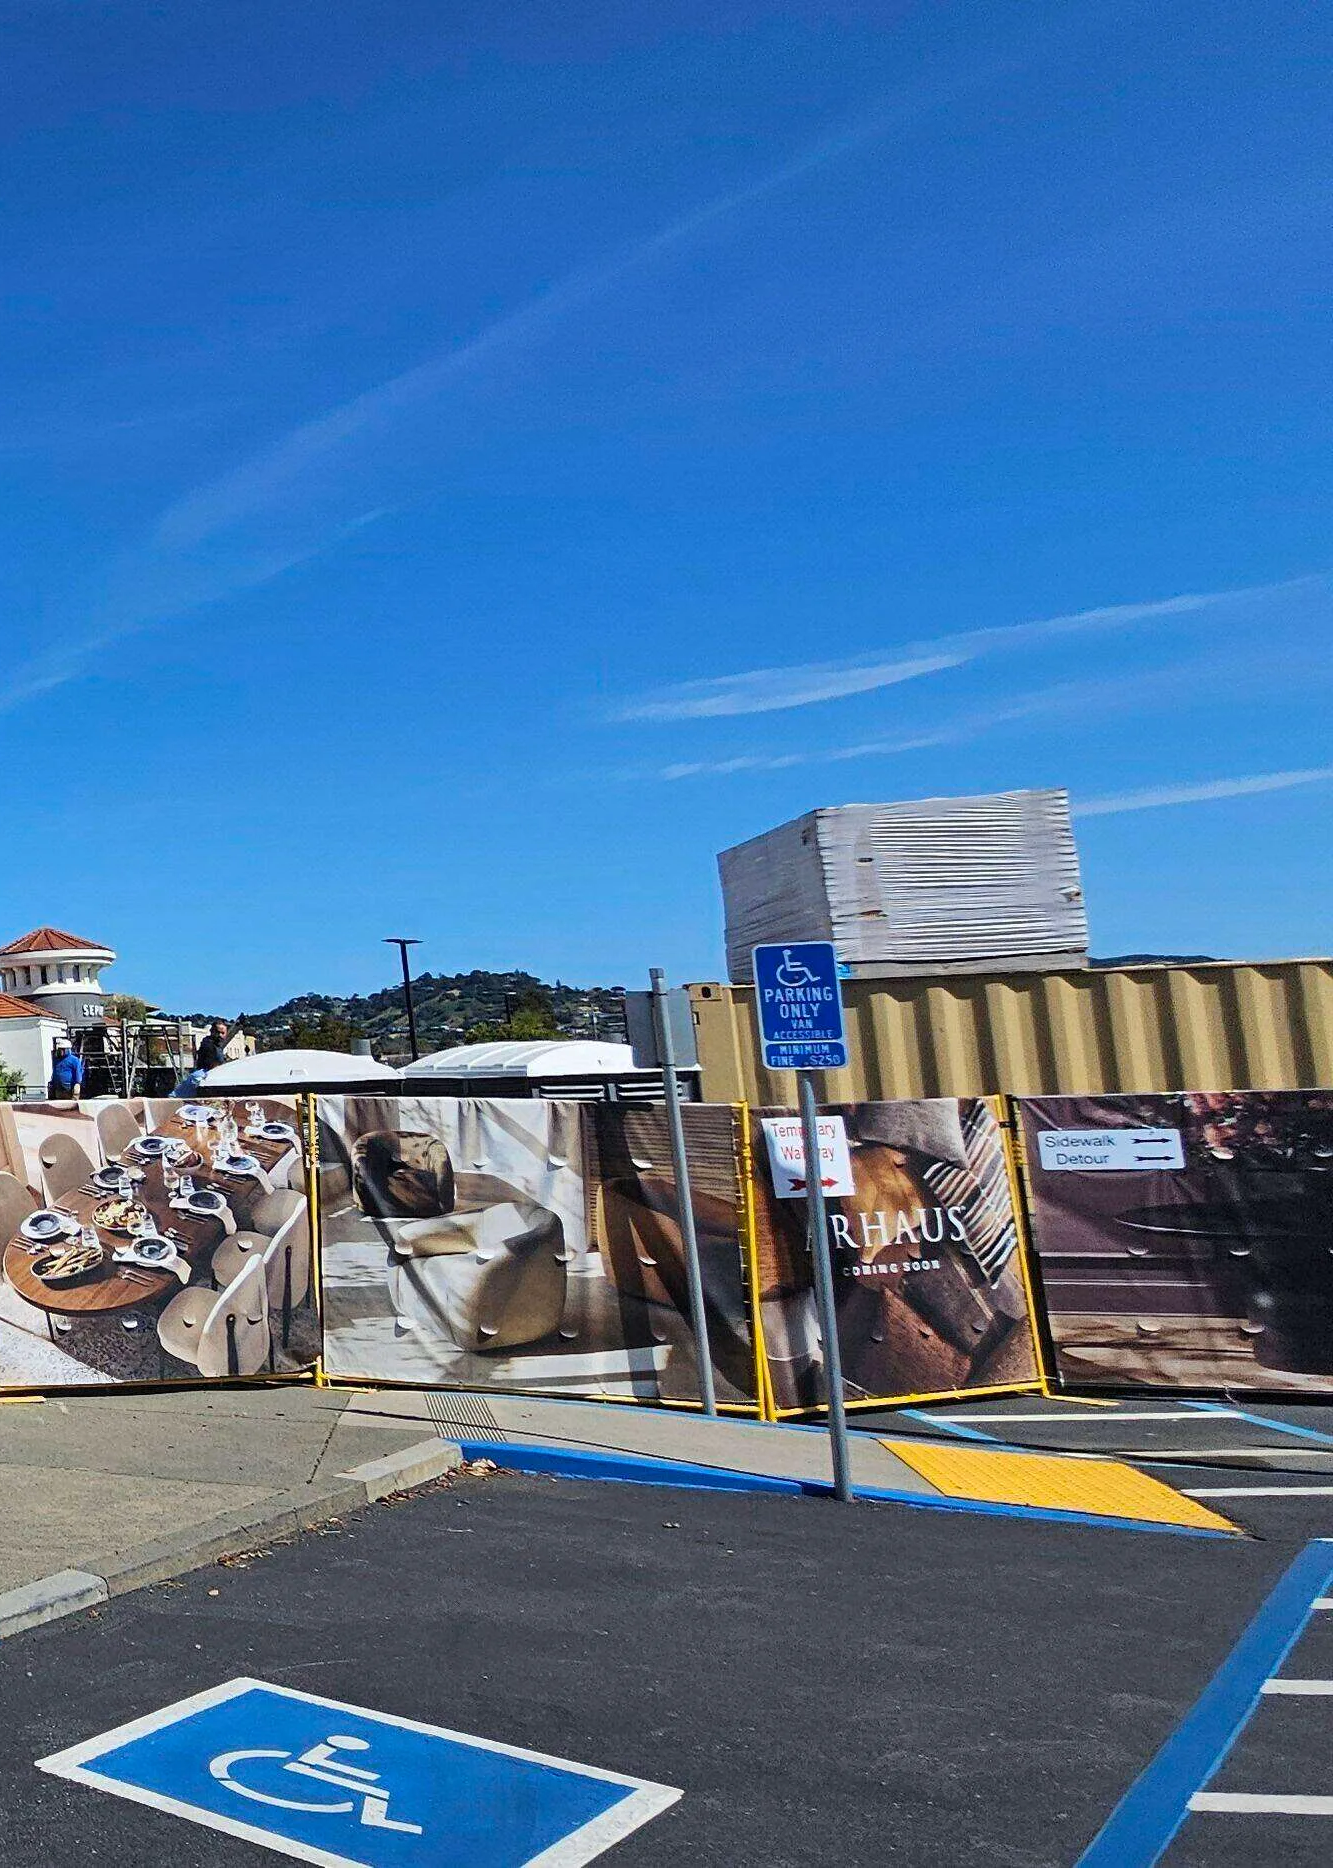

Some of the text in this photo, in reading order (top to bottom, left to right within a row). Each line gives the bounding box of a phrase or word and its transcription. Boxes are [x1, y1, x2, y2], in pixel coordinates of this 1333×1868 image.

[764, 986, 833, 1003] PARKING
[779, 1003, 820, 1019] ONLY
[791, 1019, 813, 1029] VAN
[773, 1029, 833, 1040] ACCESSIBLE
[779, 1044, 830, 1055] MINIMUM
[771, 1056, 795, 1066] FINE
[771, 1123, 836, 1138] Temary
[1045, 1134, 1116, 1148] Sidewalk
[780, 1145, 834, 1162] Waay
[1056, 1153, 1109, 1165] Detour
[843, 1260, 941, 1277] COMING SOON
